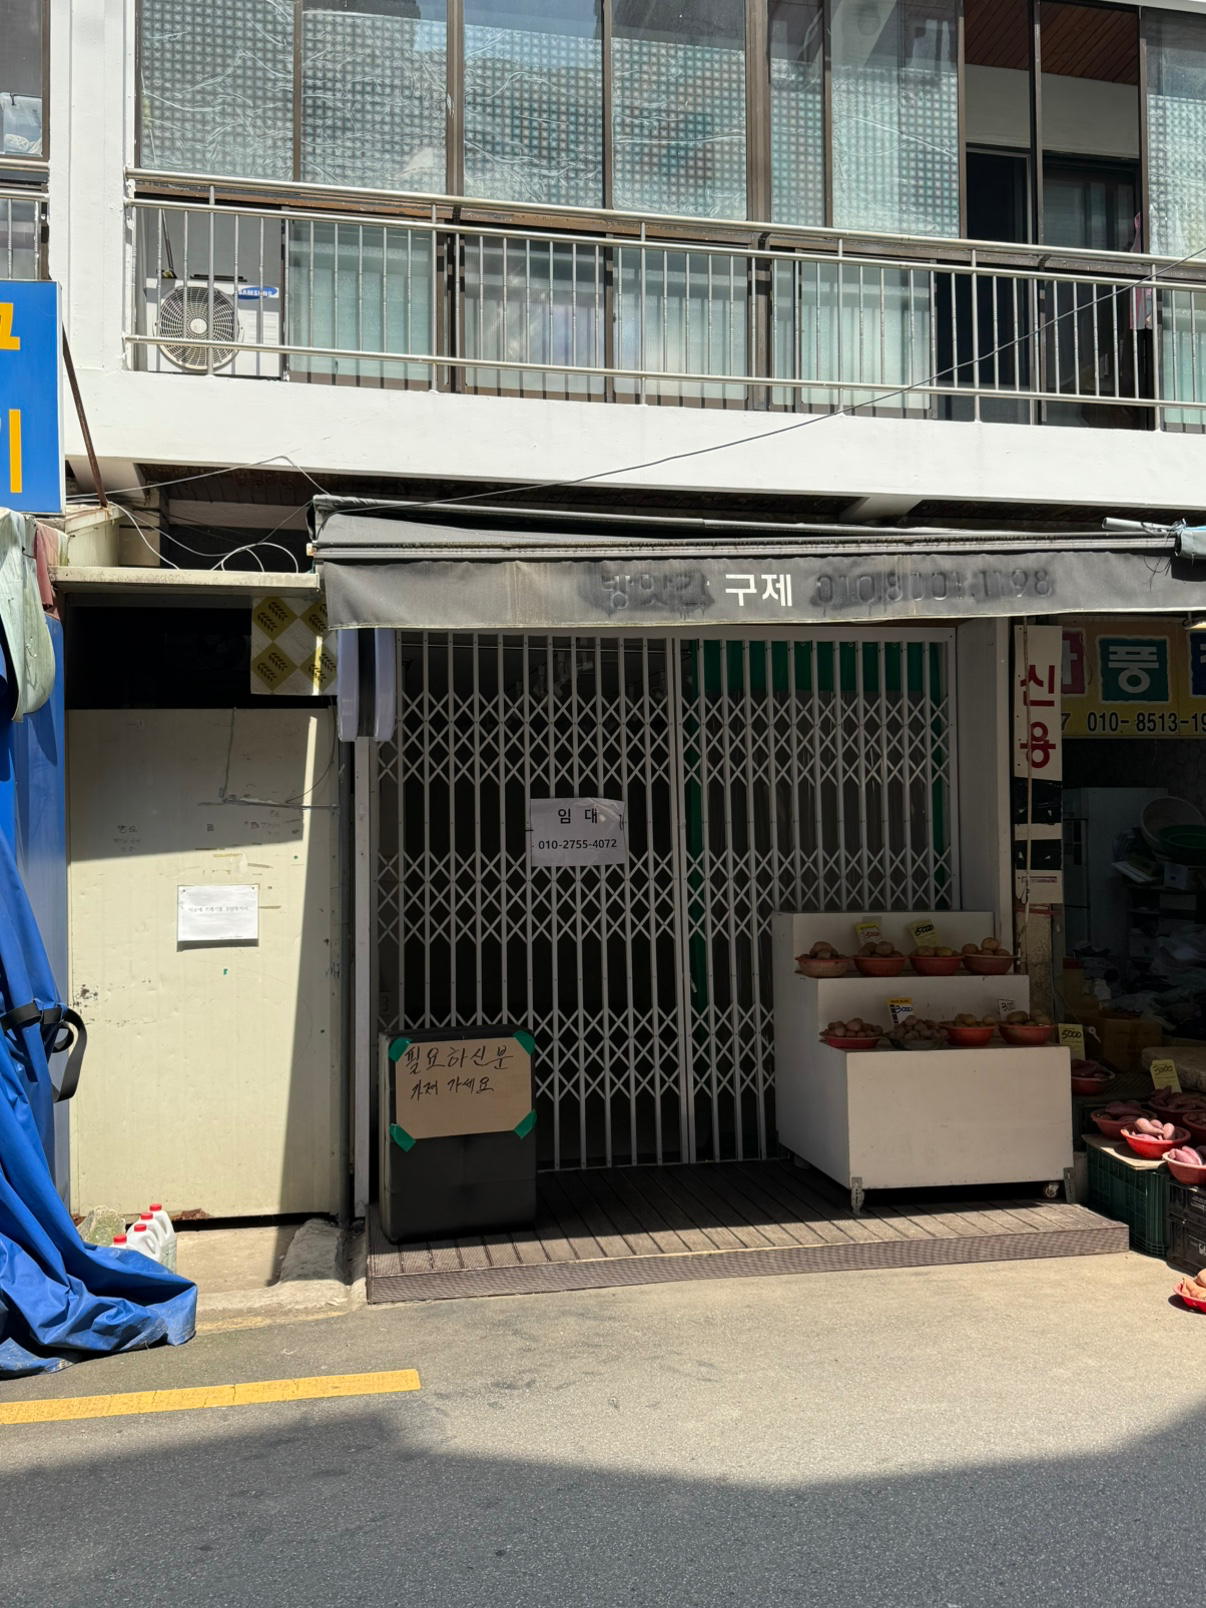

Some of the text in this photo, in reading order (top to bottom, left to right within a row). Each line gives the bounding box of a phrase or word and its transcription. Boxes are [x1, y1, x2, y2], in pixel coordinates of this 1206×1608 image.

[725, 573, 793, 607] 구제
[538, 839, 617, 850] 010-2755-4072
[1061, 1028, 1082, 1040] 5000
